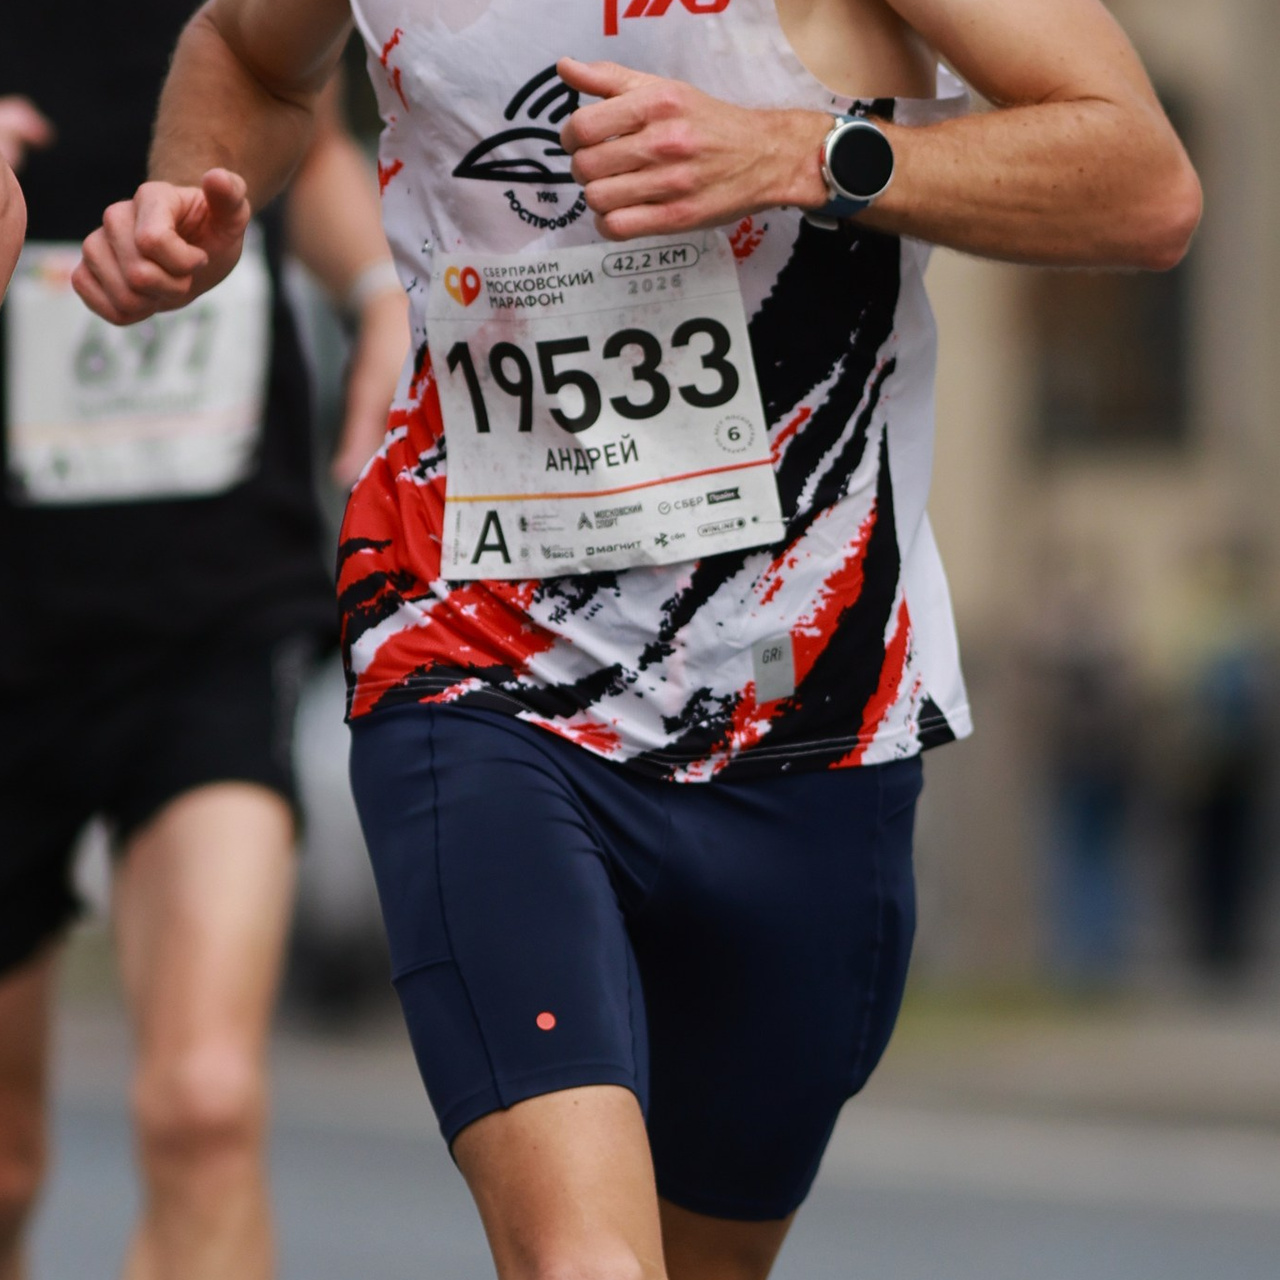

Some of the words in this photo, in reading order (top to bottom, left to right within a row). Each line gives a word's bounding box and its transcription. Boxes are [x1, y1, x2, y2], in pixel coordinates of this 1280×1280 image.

[483, 262, 559, 277] СБЕРПРАЙМ
[613, 254, 651, 271] 42,2
[659, 249, 687, 265] КМ
[486, 269, 594, 293] МОСКОВСКИЙ
[489, 292, 564, 308] МАРАФОН
[446, 317, 740, 434] 19533
[728, 426, 741, 441] 6
[545, 434, 639, 475] АНДРЕЙ
[673, 497, 704, 510] СБЕР
